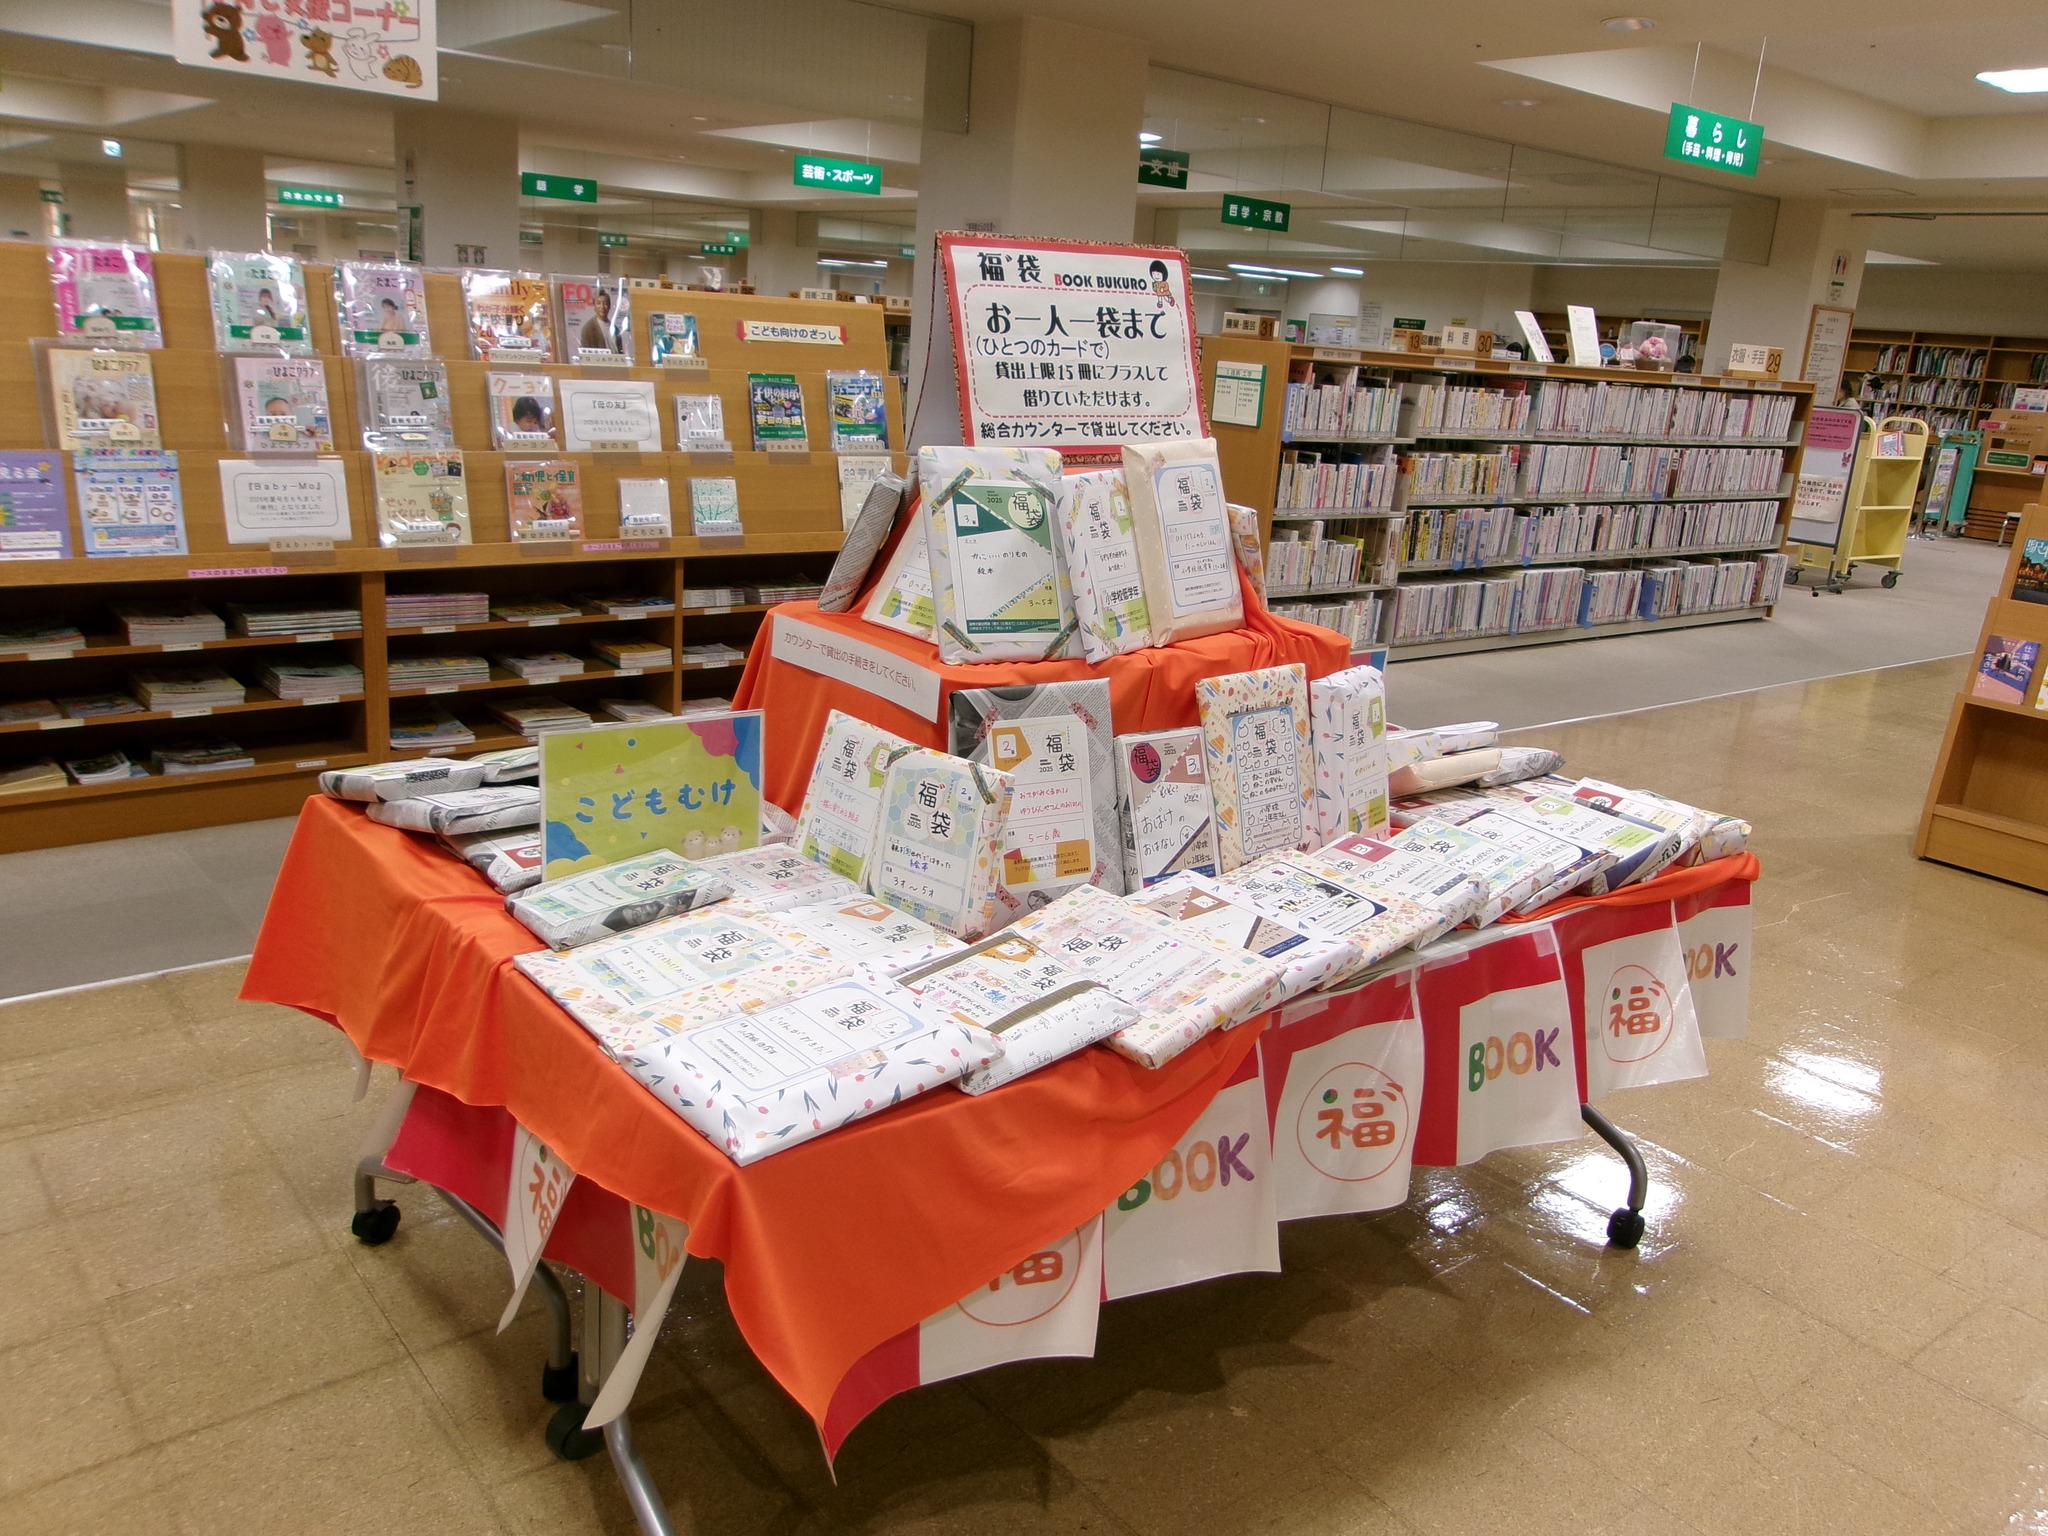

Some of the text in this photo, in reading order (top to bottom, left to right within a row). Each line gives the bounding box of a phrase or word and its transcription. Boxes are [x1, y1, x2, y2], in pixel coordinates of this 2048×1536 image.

[1685, 114, 1747, 149] 暮らし
[802, 164, 874, 185] 芸術・スポーツ
[536, 179, 584, 196] 語学
[1229, 203, 1284, 225] 哲学・宗教
[1054, 273, 1148, 291] BOOK BUKURO
[985, 302, 1168, 339] お一人一袋まで
[1260, 320, 1275, 338] 31
[751, 325, 837, 342] こども向けのざっし
[1409, 334, 1420, 350] 13
[976, 335, 1110, 359] (ひとつのカードで)
[1477, 335, 1493, 353] 30
[1732, 346, 1781, 373] 衣服・手芸 29
[1023, 389, 1152, 408] 借りていただけます。
[980, 421, 1192, 440] 総合カウンターで貸出してください。
[513, 441, 548, 449] クーヨン
[978, 566, 994, 575] 絵本
[784, 631, 917, 692] カウンターで貸出の手続きをしてください。
[1003, 741, 1011, 752] 2
[1253, 723, 1278, 757] 福袋
[1046, 734, 1076, 773] 福袋
[1133, 745, 1160, 778] 福袋
[1188, 757, 1197, 773] 3
[961, 787, 967, 795] 2
[575, 778, 737, 824] こどもむけ
[918, 780, 952, 838] 福袋
[907, 820, 921, 829] 2025
[1062, 934, 1129, 953] 福袋
[1468, 1027, 1561, 1092] BOOK
